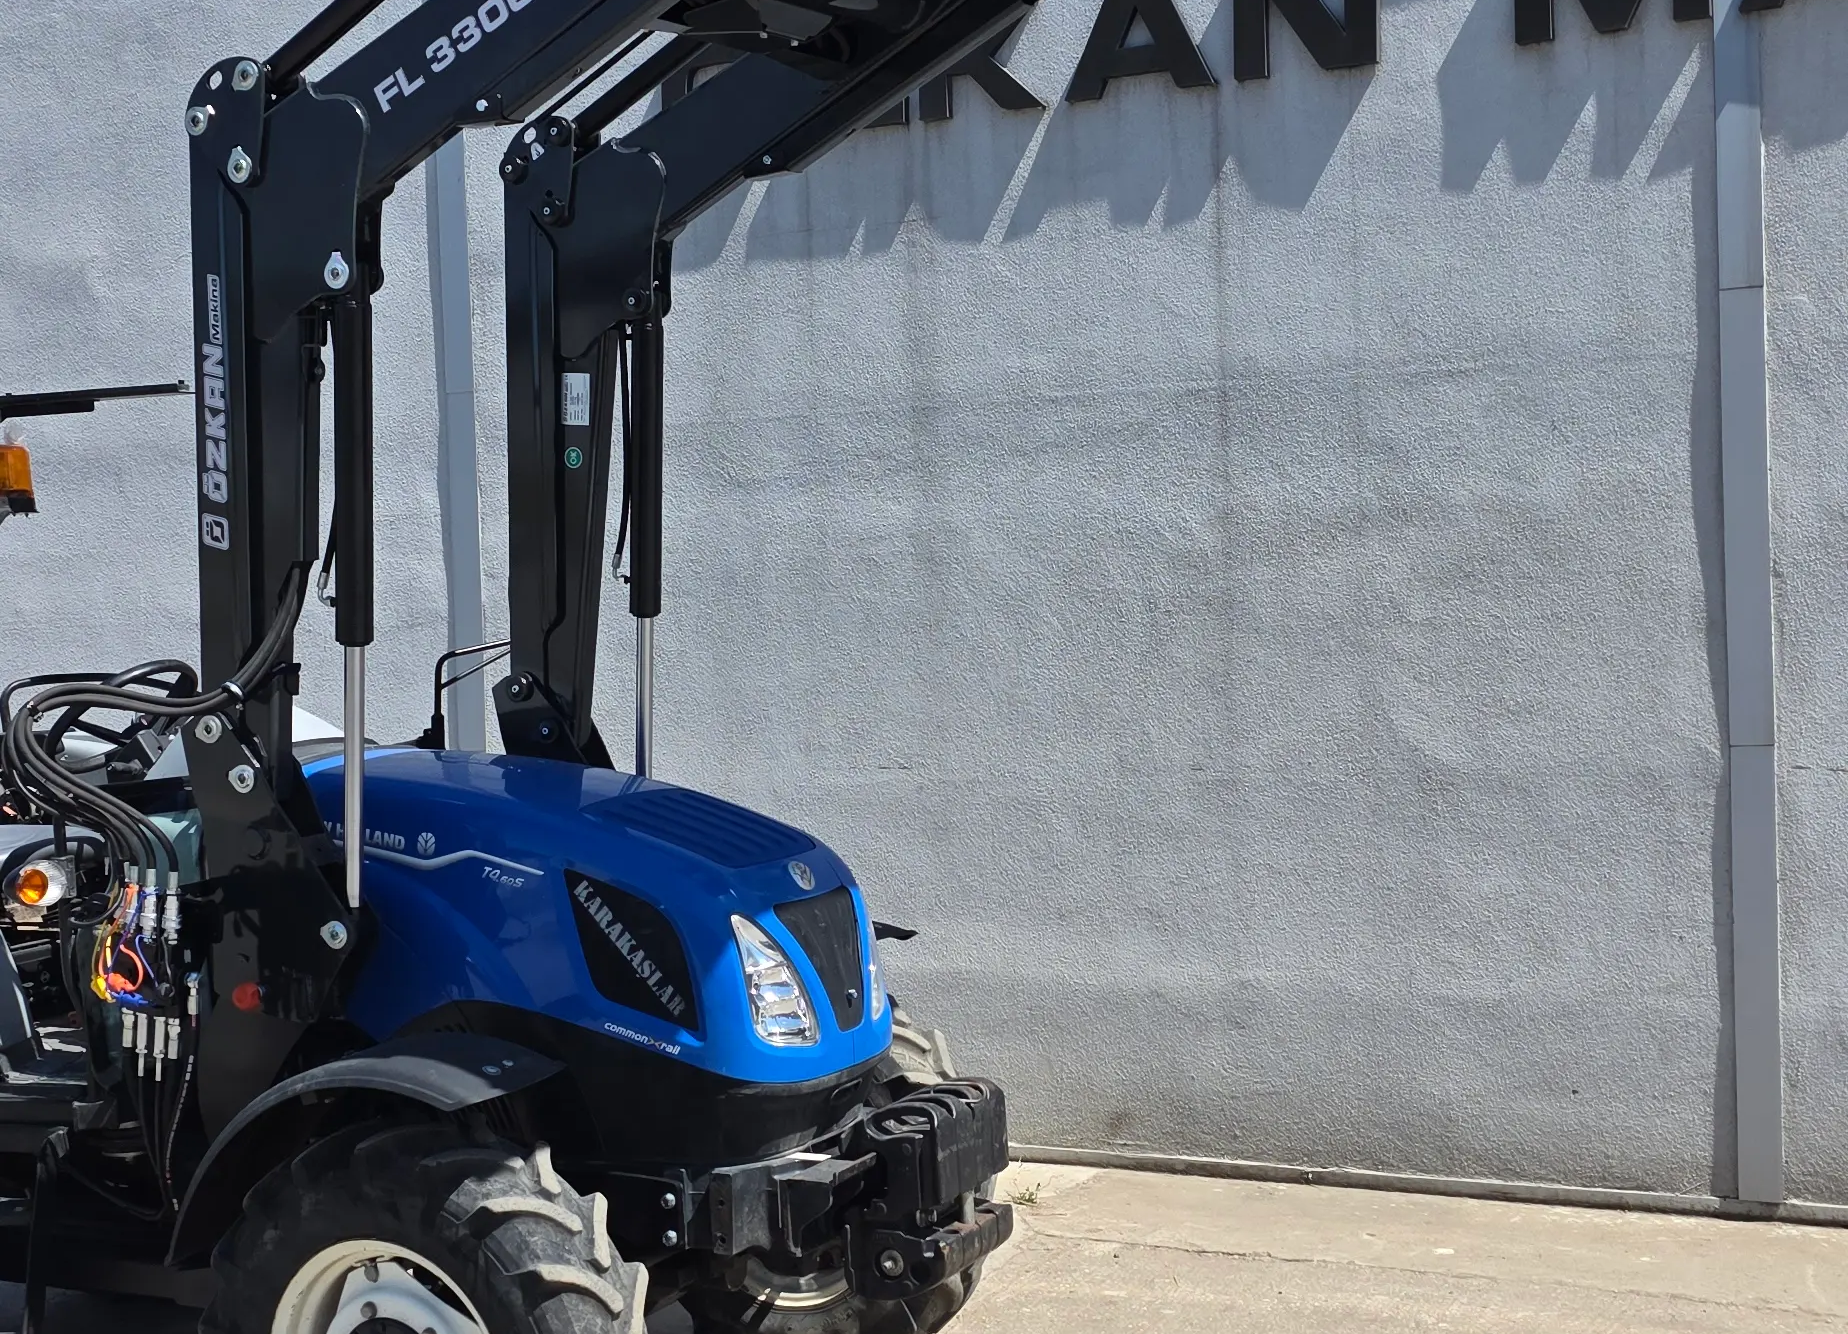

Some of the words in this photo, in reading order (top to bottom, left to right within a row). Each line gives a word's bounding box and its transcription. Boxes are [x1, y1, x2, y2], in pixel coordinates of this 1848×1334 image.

[373, 67, 426, 114] FL
[210, 278, 221, 341] Makina
[202, 343, 228, 504] ÖZKAN
[569, 450, 578, 465] OK
[336, 823, 406, 851] HLAND
[573, 880, 686, 1016] KARAKAŞLAR
[604, 1021, 649, 1045] common
[660, 1041, 681, 1055] rail
